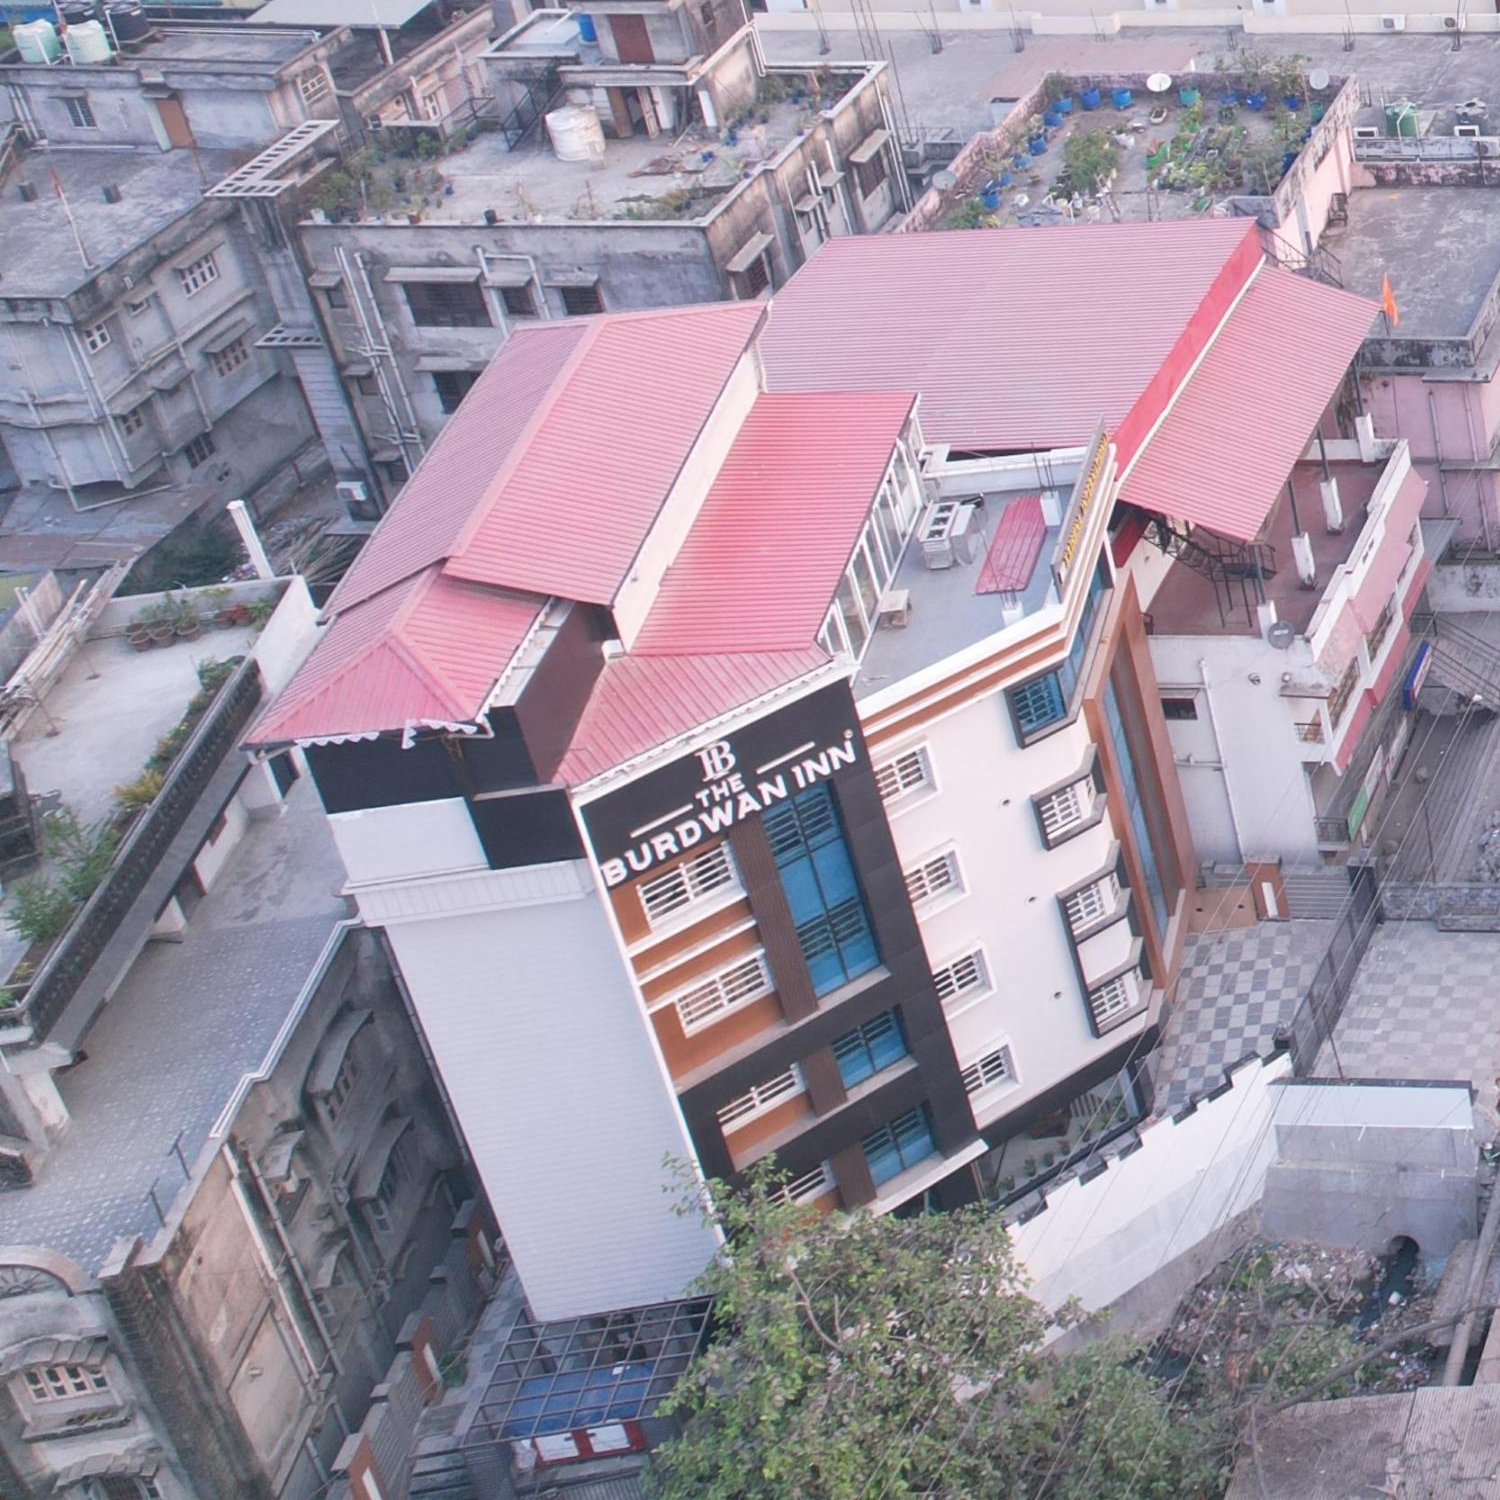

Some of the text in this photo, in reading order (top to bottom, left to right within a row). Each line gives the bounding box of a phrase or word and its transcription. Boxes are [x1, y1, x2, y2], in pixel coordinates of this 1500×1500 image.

[601, 739, 857, 887] BURDWAN INN
[695, 772, 746, 808] THE
